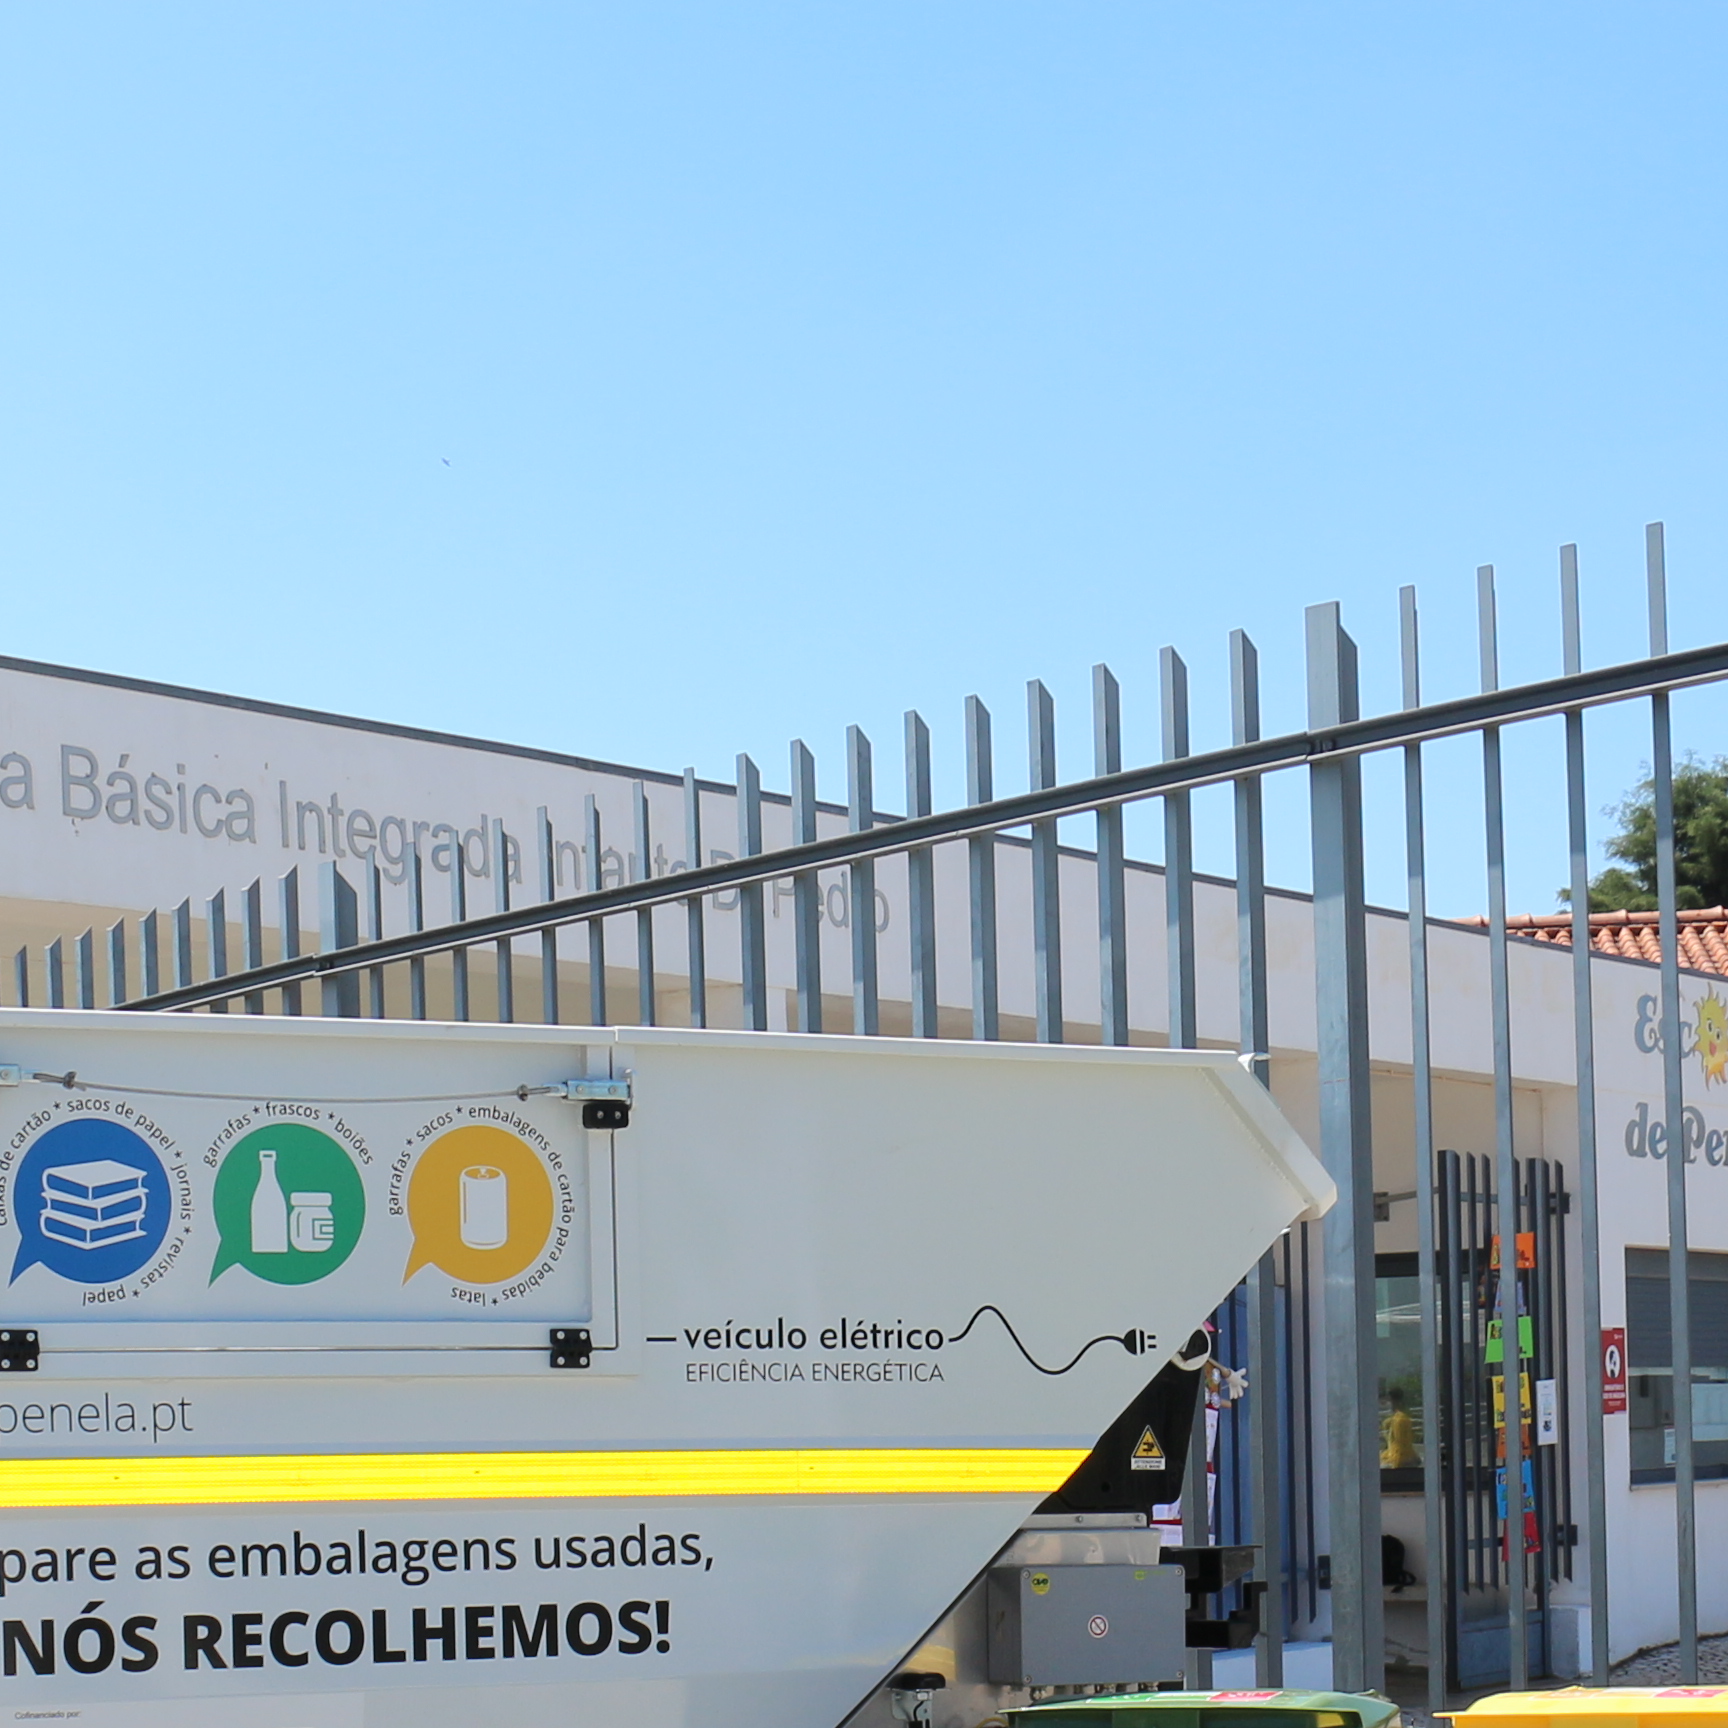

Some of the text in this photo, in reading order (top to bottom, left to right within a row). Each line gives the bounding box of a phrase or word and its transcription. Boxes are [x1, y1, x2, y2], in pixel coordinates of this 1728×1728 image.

[61, 743, 256, 845] Básica
[11, 1110, 52, 1150] cartão
[67, 1098, 110, 1113] sacos
[115, 1102, 134, 1119] de
[134, 1114, 176, 1151] papel
[1625, 1102, 1668, 1160] de
[202, 1101, 374, 1169] garrafas frascos boiões
[170, 1161, 195, 1221] jornais
[389, 1105, 576, 1307] garrafas sacos embalagens de cartão para bebidas latas
[140, 1236, 185, 1290] revistas
[82, 1284, 126, 1307] papel
[683, 1316, 945, 1351] veículo elétrico
[685, 1359, 945, 1382] EFICIÊNCIA ENERGÉTICA
[134, 1543, 191, 1581] as
[207, 1528, 517, 1585] embalagens
[534, 1523, 715, 1573] usadas,
[1, 1598, 673, 1678] NÓS RECOLHEMOS!
